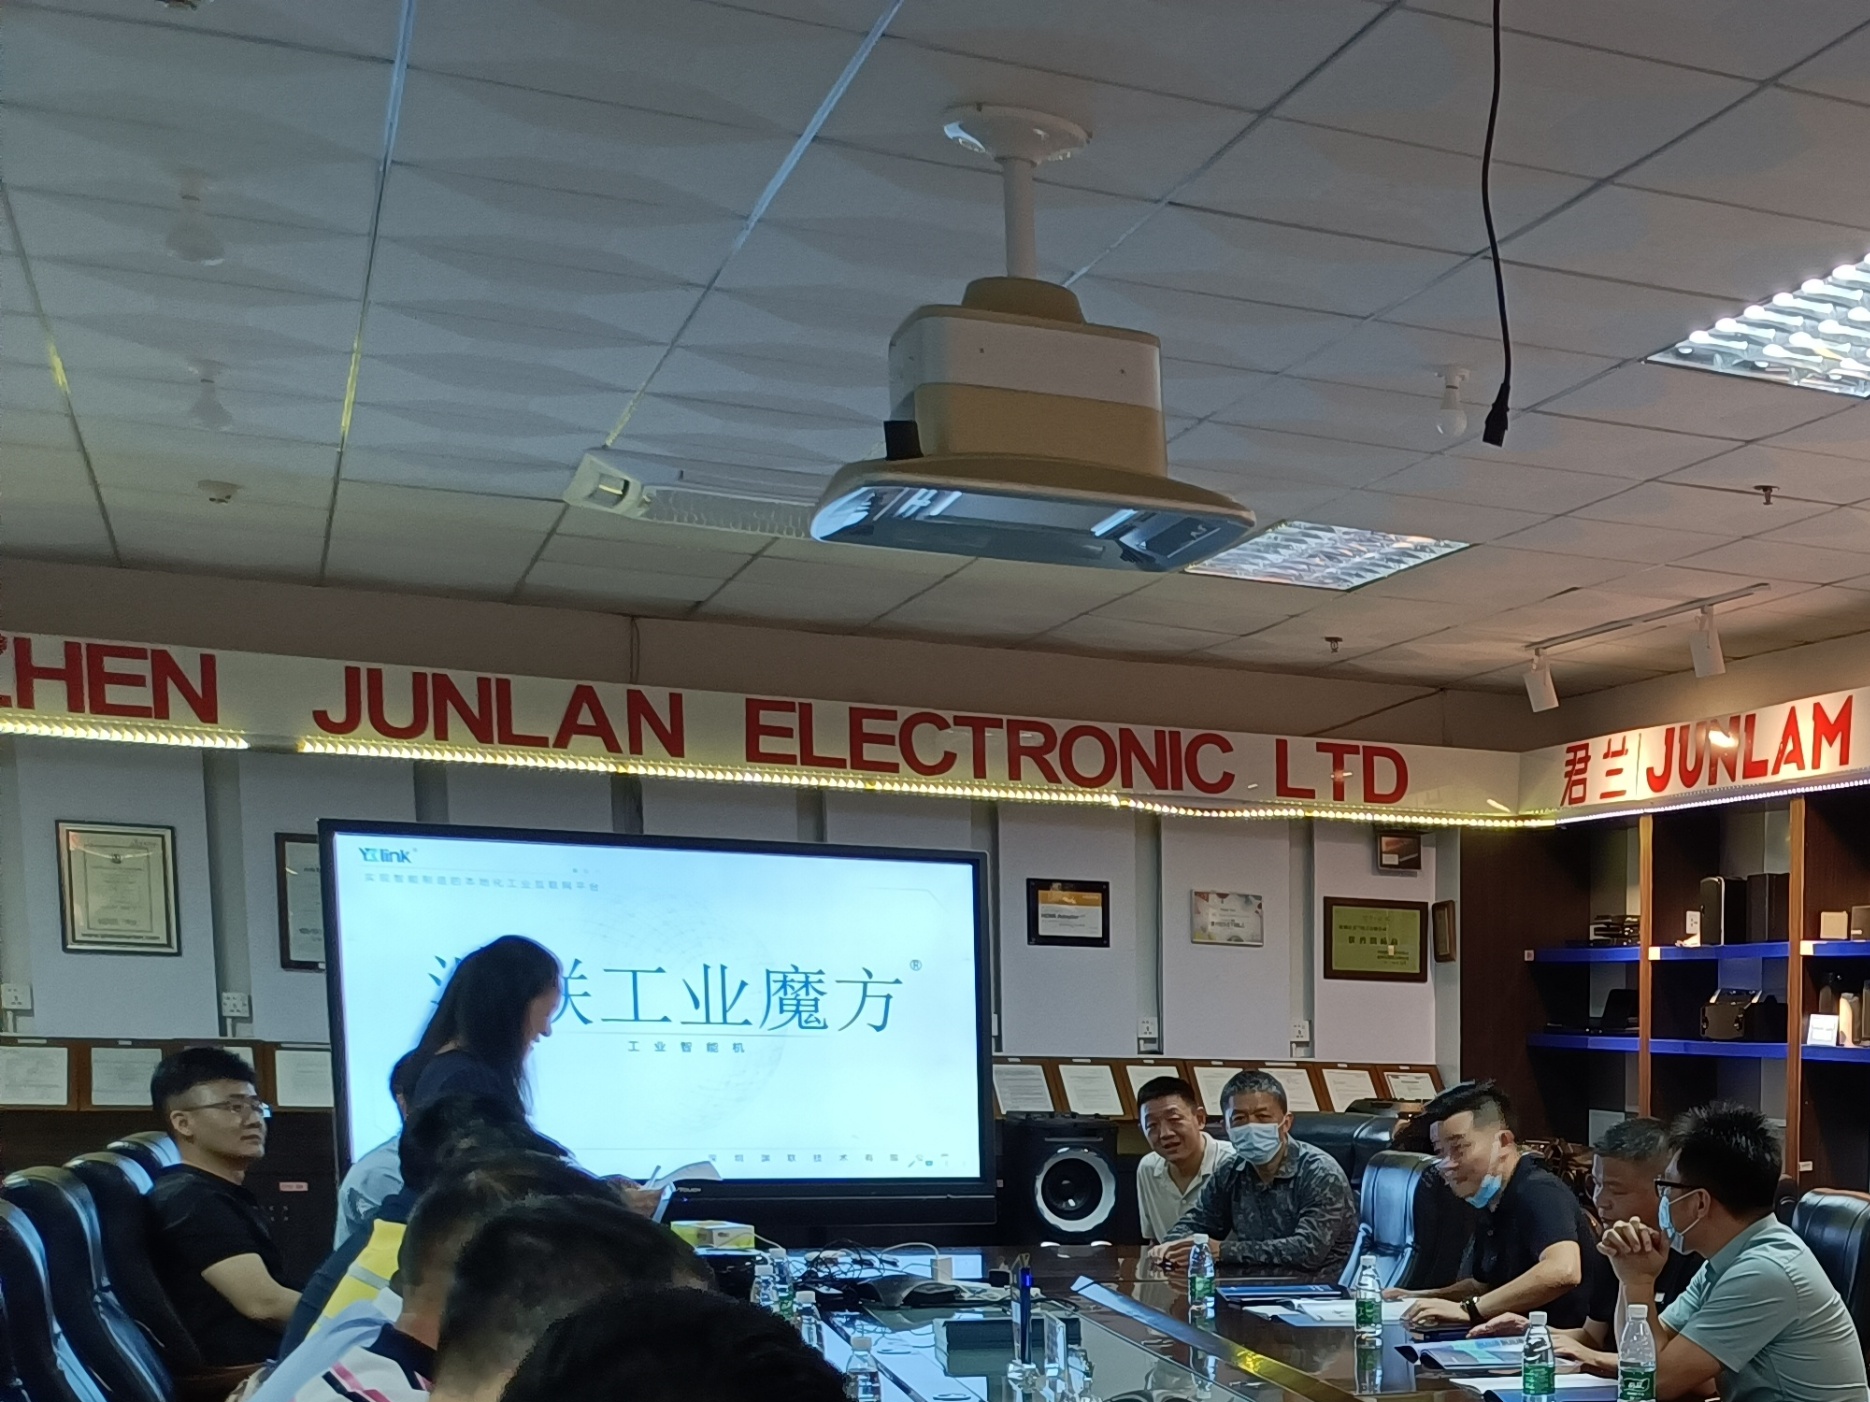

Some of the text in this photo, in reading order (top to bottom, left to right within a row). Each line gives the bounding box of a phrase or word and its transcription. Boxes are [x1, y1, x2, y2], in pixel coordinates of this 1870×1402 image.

[311, 665, 685, 758] JUNLAN
[744, 697, 1235, 794] ELECTRONIC
[1275, 738, 1410, 805] LTD
[1645, 694, 1856, 793] JUNLAM
